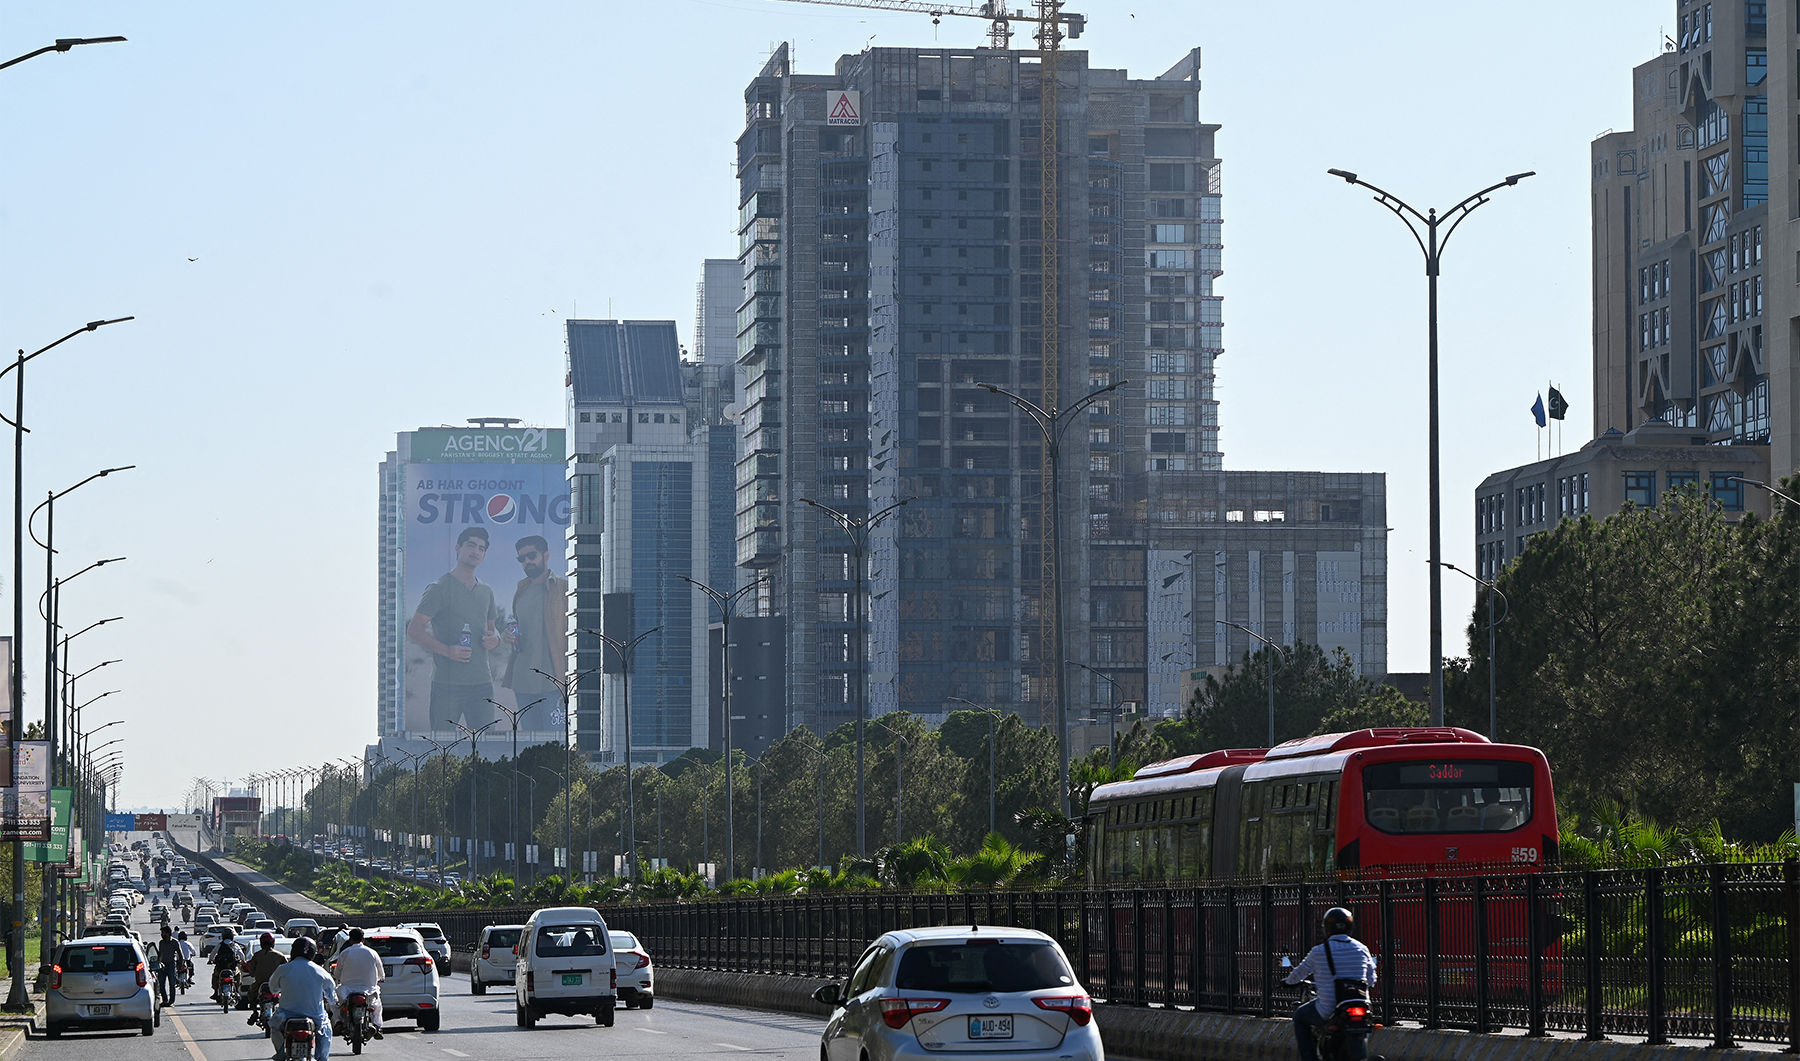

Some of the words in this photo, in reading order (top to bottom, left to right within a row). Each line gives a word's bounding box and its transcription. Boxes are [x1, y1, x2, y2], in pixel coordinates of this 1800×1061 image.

[416, 479, 434, 490] AB
[437, 479, 463, 490] HAR
[468, 479, 525, 490] GHOONT
[1429, 764, 1465, 779] Saddar
[29, 818, 41, 826] 333
[1520, 847, 1538, 863] 59
[982, 1020, 1010, 1032] AUD-494
